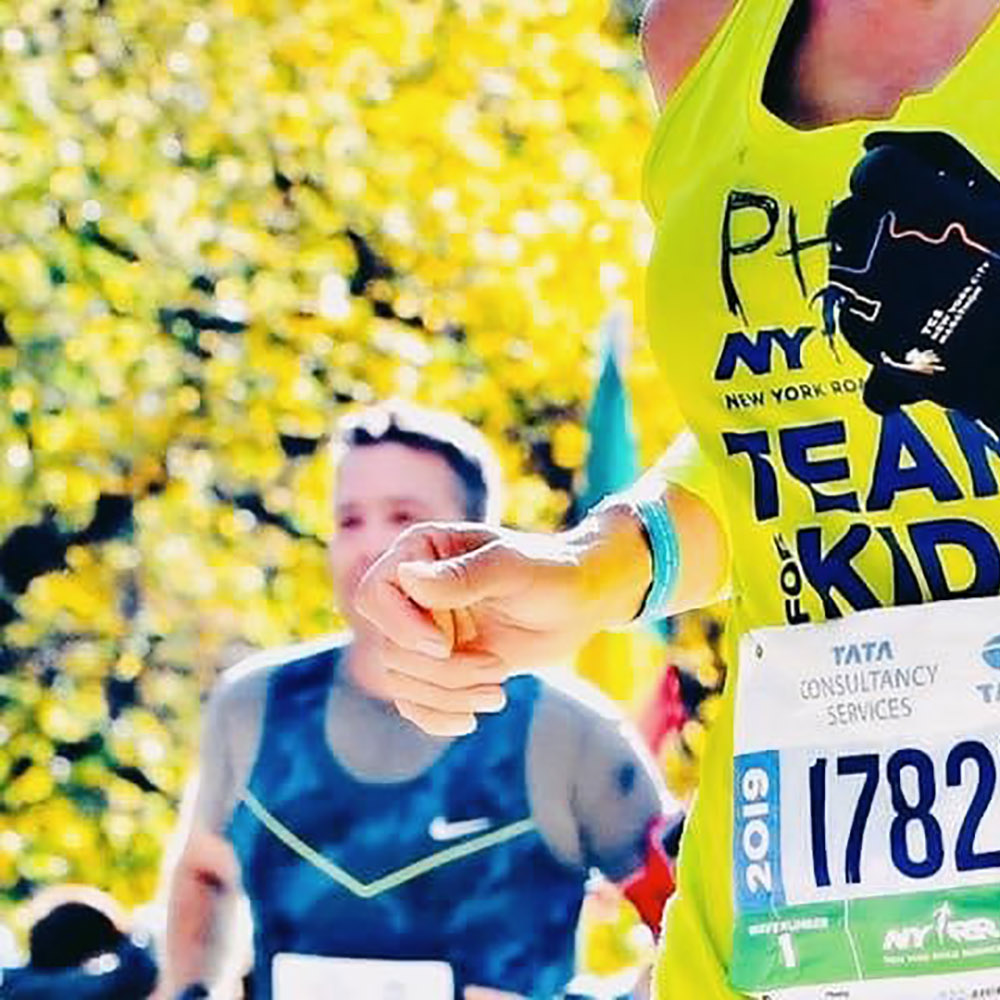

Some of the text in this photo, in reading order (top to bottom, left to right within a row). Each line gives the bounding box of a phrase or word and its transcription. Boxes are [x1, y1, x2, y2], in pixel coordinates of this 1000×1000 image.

[725, 392, 765, 409] NEW
[771, 383, 827, 403] YORK
[833, 640, 893, 666] TATA
[800, 664, 939, 700] CONSULTANCY
[826, 697, 913, 726] SERVICES
[742, 767, 773, 893] 2019
[778, 932, 797, 968] 1
